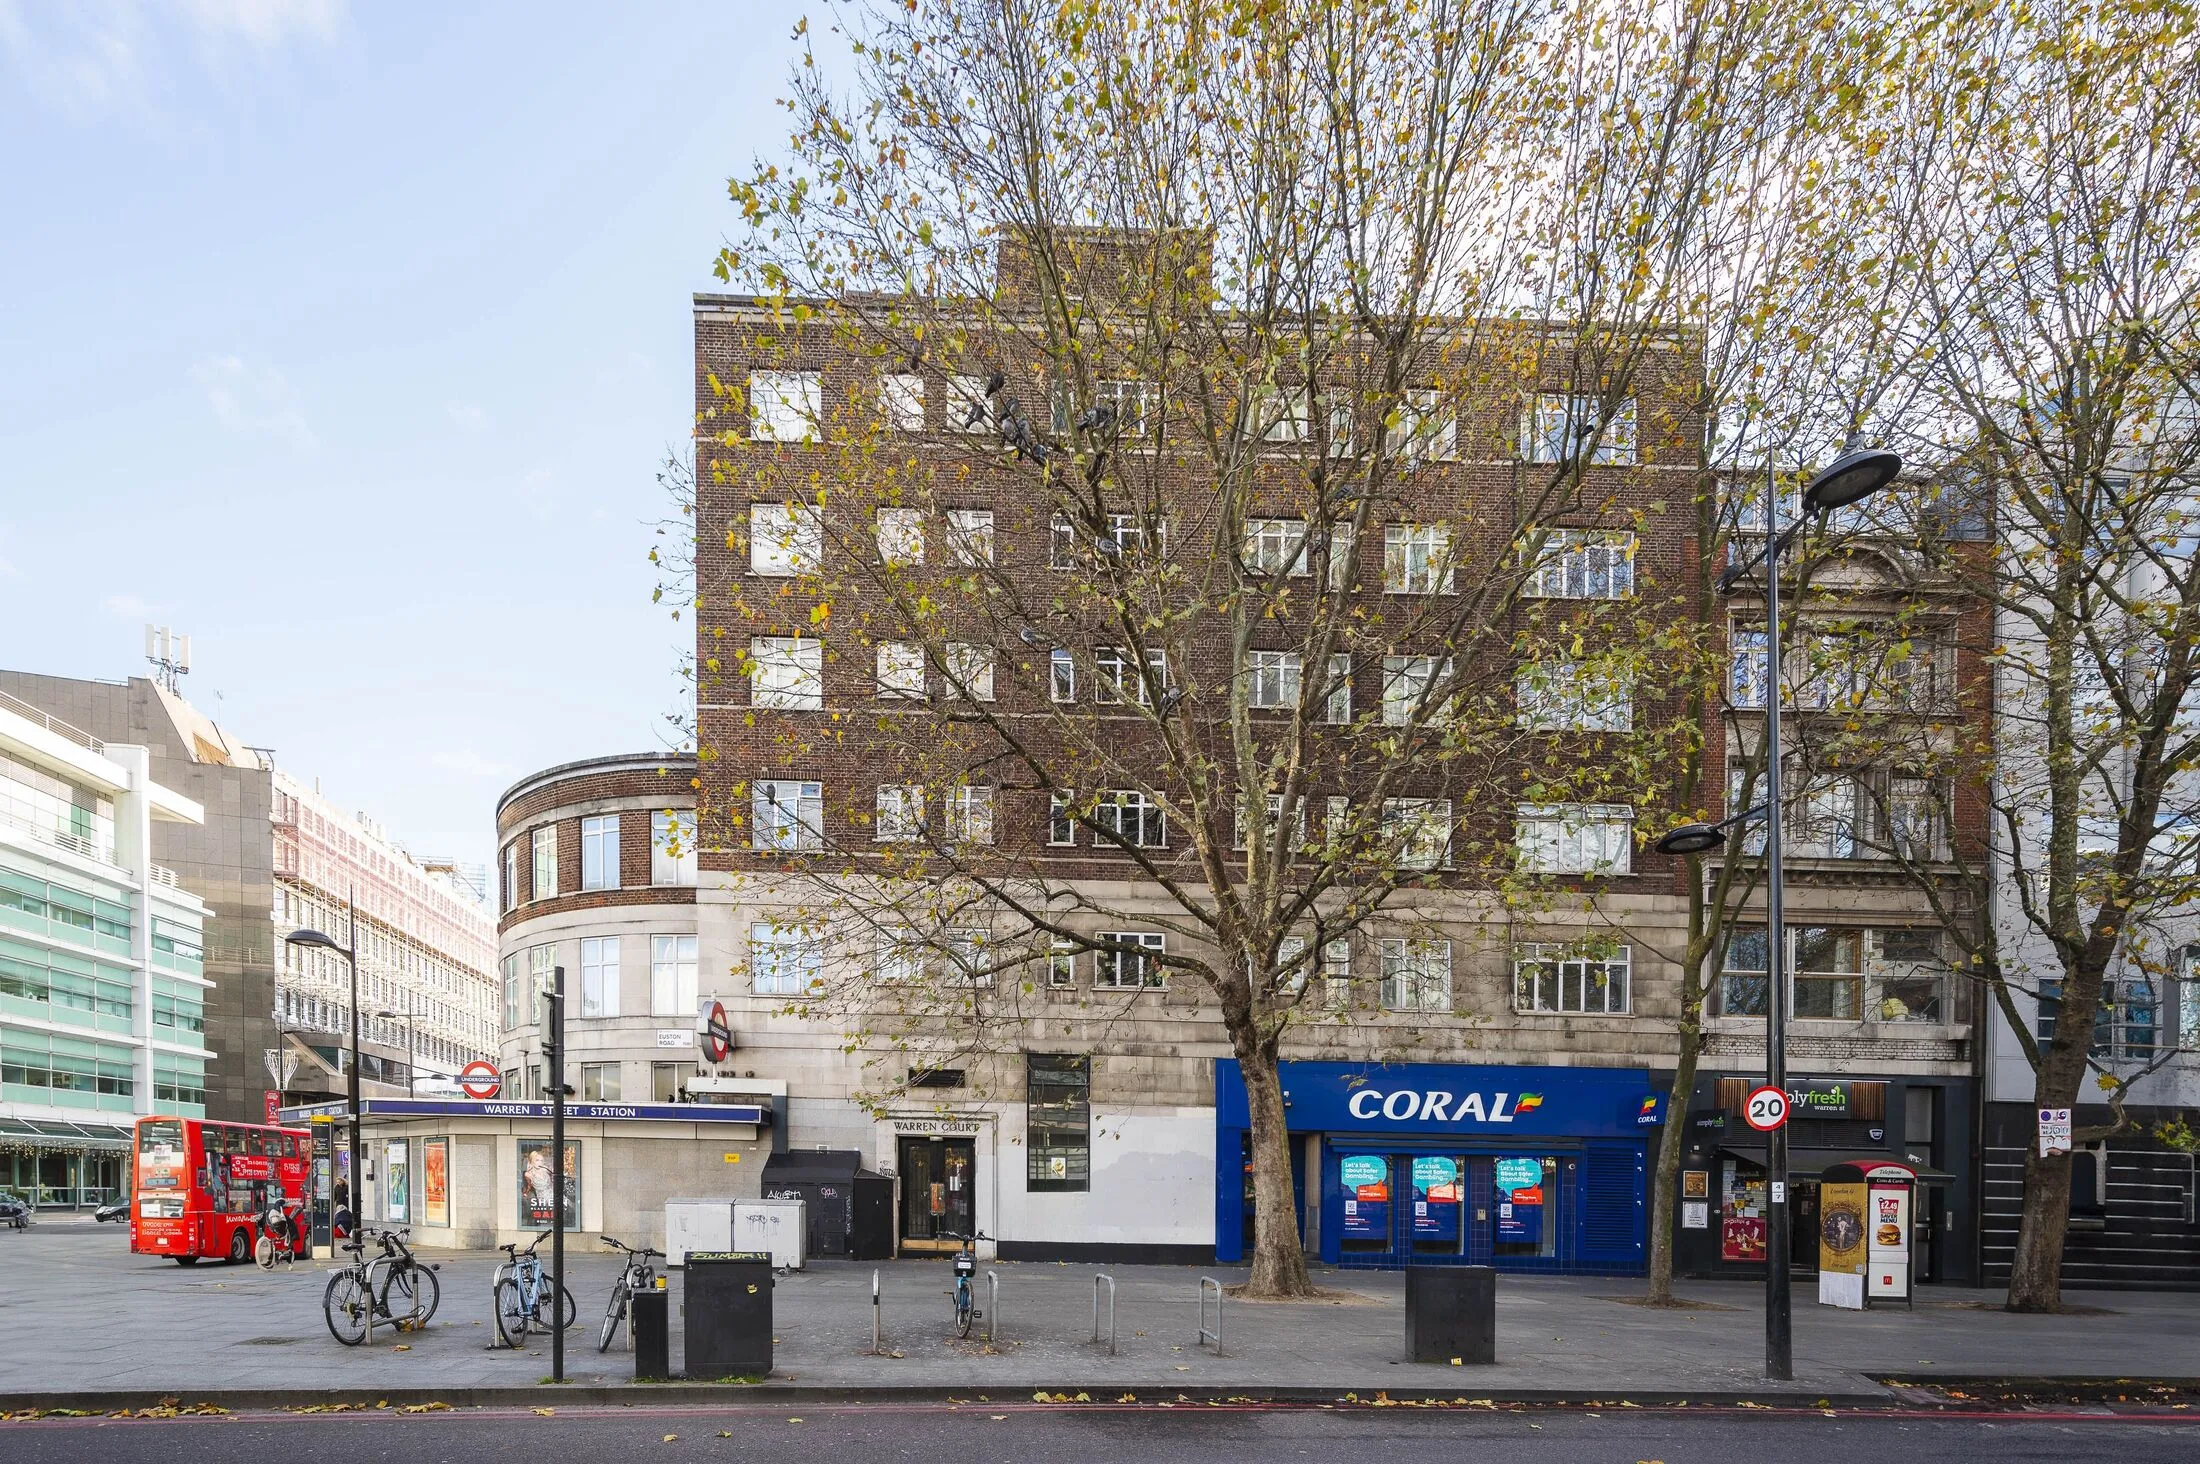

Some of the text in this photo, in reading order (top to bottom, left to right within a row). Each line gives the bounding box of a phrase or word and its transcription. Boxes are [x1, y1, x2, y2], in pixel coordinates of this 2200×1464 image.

[484, 1105, 636, 1117] WARREN STET STATION
[1349, 1090, 1515, 1122] CORAL
[1752, 1098, 1783, 1118] 20
[1638, 1115, 1657, 1123] CORAL
[894, 1122, 980, 1132] WARREN COURT
[530, 1198, 568, 1207] SHEN
[1881, 1200, 1897, 1210] £2.49
